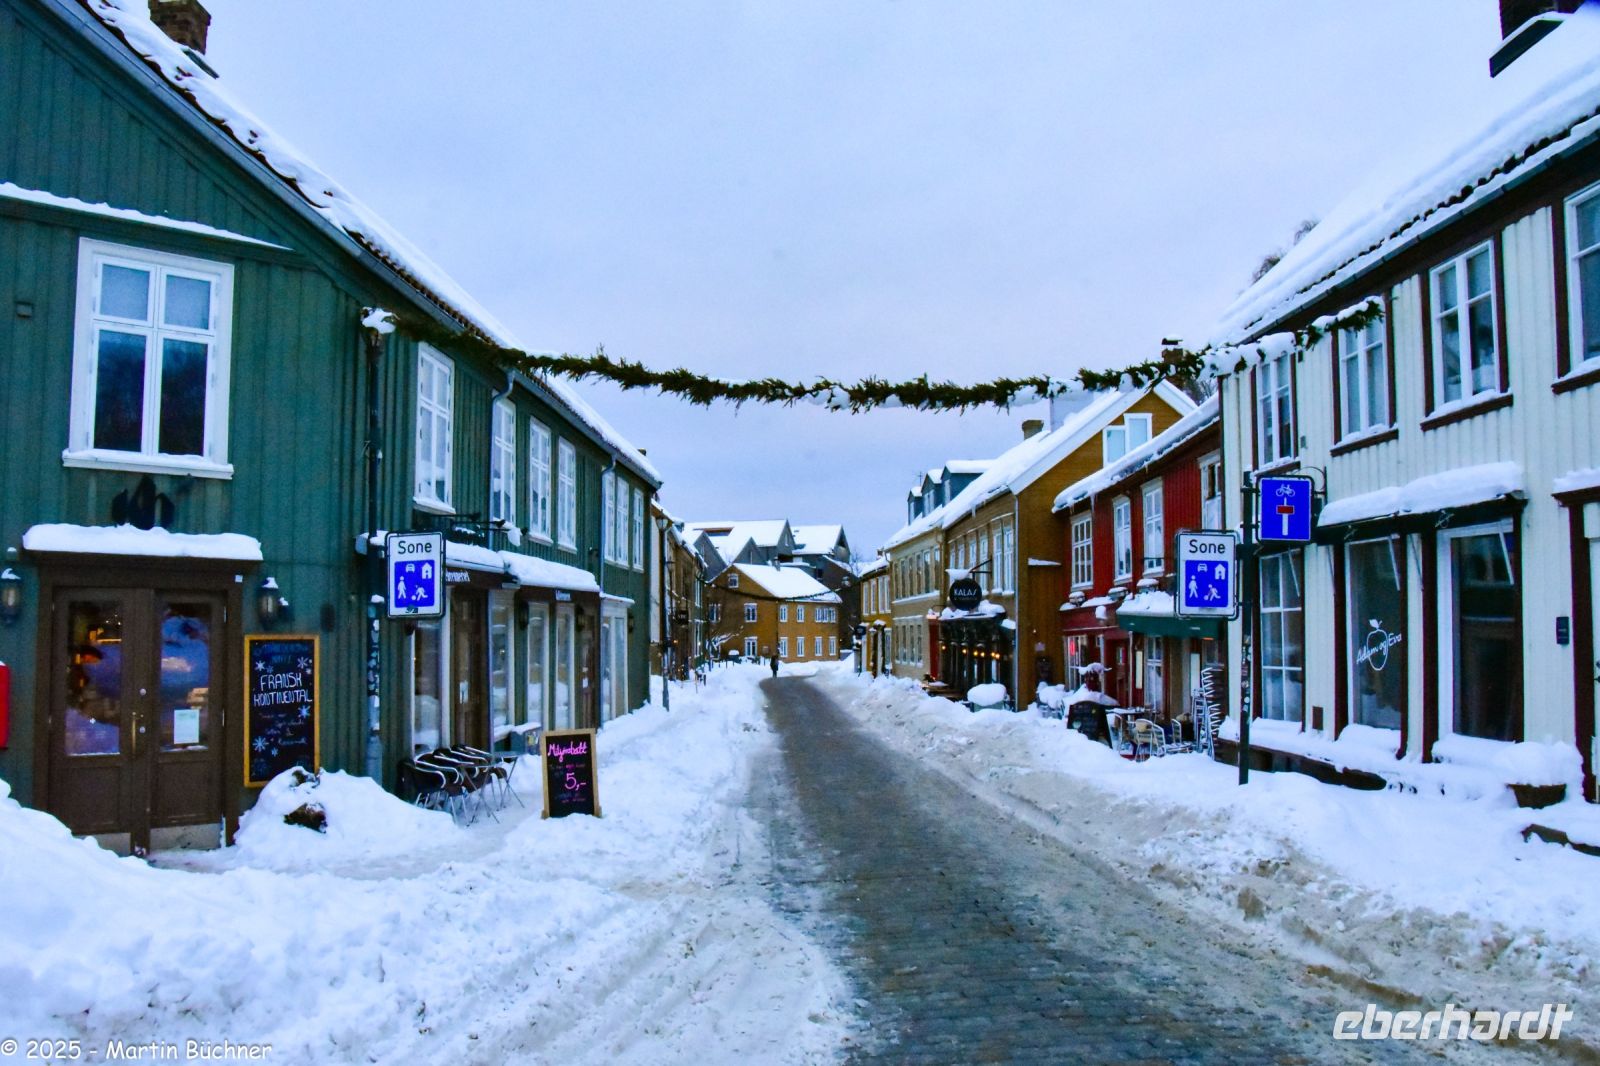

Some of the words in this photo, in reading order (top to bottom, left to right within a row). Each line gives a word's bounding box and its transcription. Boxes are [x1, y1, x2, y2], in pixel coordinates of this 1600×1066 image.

[397, 540, 433, 555] Sone
[1189, 539, 1227, 555] Sone
[260, 672, 303, 691] FRANSK
[253, 689, 313, 707] KONTINENTAL
[564, 772, 587, 791] 5,-
